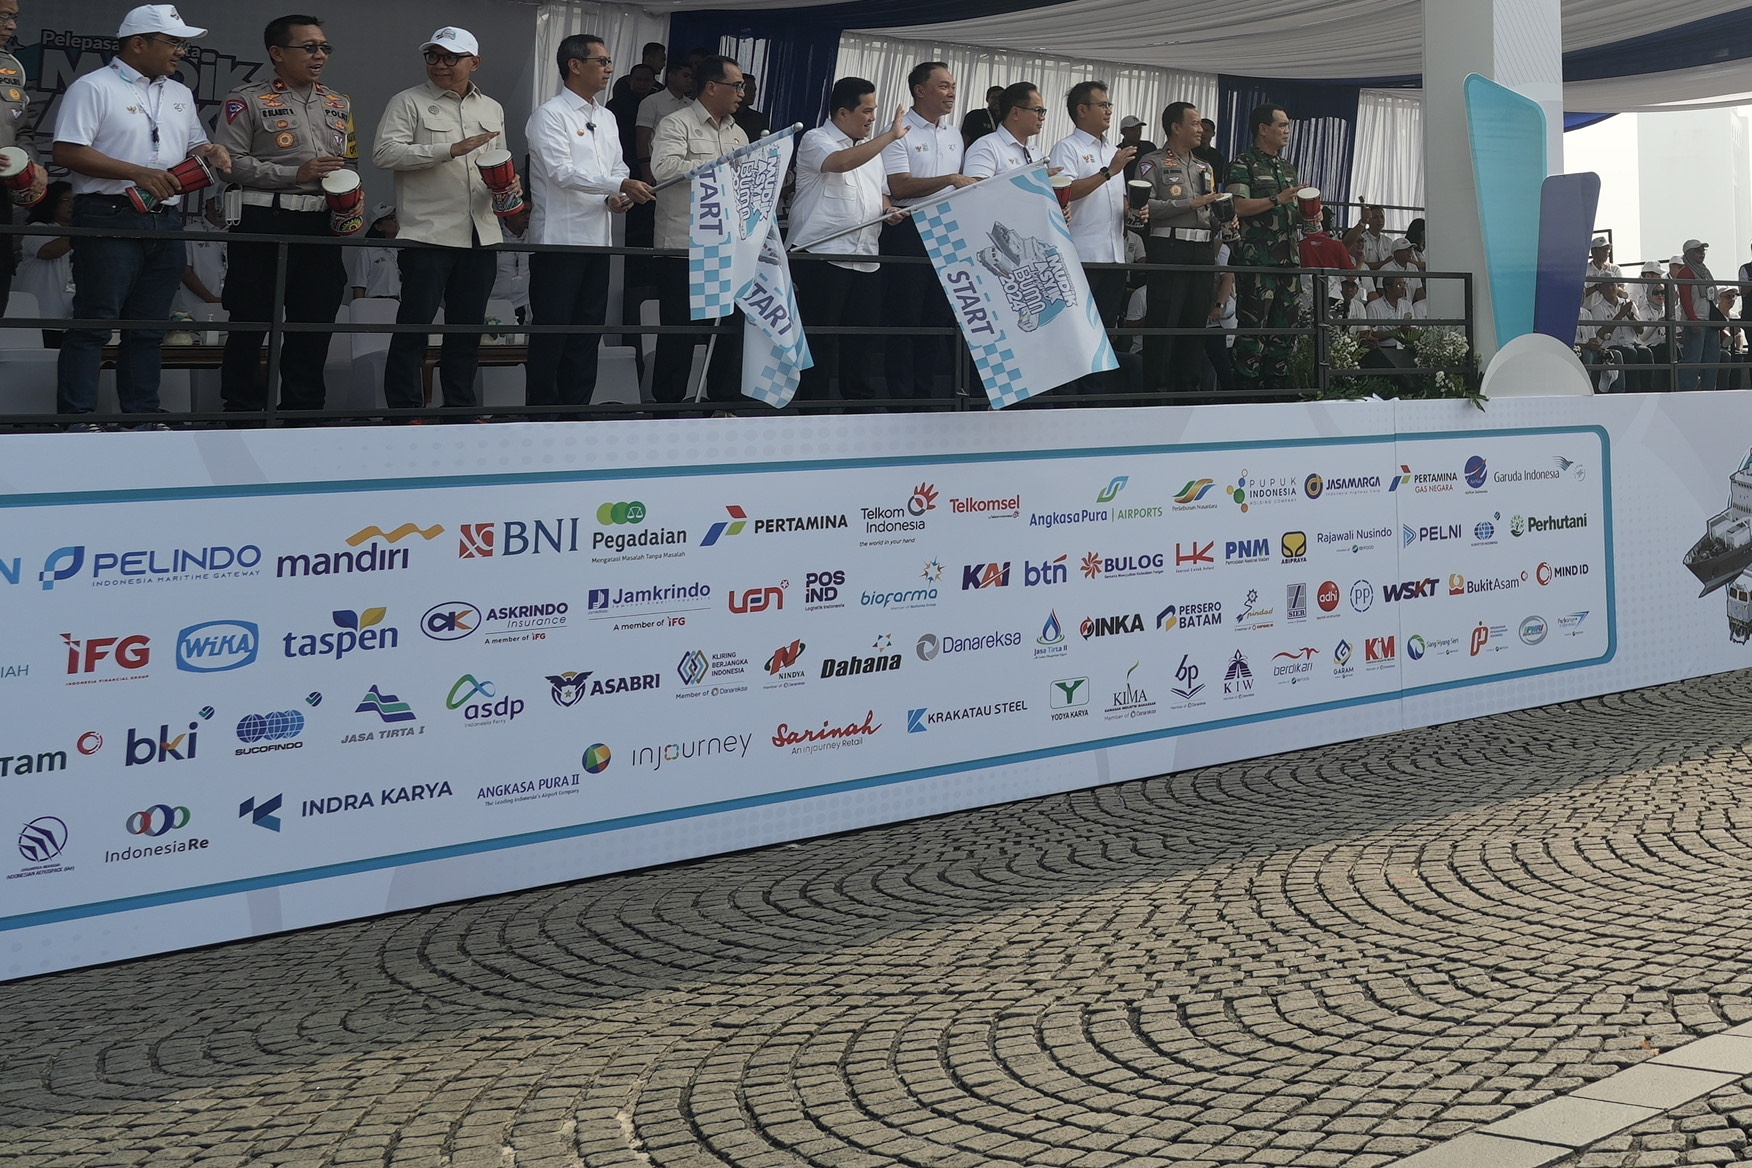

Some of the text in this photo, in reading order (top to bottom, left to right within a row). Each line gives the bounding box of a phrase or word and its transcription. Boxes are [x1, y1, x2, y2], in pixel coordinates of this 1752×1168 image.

[325, 109, 348, 122] POLRI
[998, 273, 1027, 312] 2024
[946, 270, 996, 335] START
[1249, 477, 1297, 488] PUPUK
[1326, 476, 1381, 491] JASAMARGA
[1414, 472, 1458, 484] PERTAMINA
[1494, 469, 1560, 483] Garuda Indonesia
[1249, 487, 1297, 499] INDONESIA
[1415, 484, 1454, 493] GAS NEGARA
[949, 494, 1021, 514] Telkomsel
[1117, 506, 1163, 520] AIRPORTS
[860, 506, 905, 521] Telkom
[754, 514, 849, 534] PERTAMINA
[865, 520, 926, 533] Indonesia
[1527, 513, 1588, 533] Perhutani
[501, 517, 580, 557] BNI
[592, 527, 687, 553] Pegadaian
[1316, 526, 1393, 545] Rajawali Nusindo
[1419, 524, 1462, 542] PELNI
[591, 555, 621, 564] Mengatasi
[621, 554, 645, 562] Masalah
[663, 551, 686, 559] Masalah
[1175, 540, 1215, 566] HK
[1225, 538, 1270, 559] PNM
[93, 545, 262, 579] PELINDO
[276, 542, 410, 579] mandiri
[1104, 553, 1164, 573] BULOG
[92, 569, 261, 587] INDONESIA MARITIME GATEWAY
[805, 570, 846, 588] POS
[1024, 558, 1069, 587] btn
[1554, 563, 1589, 578] MIND ID
[612, 581, 711, 605] Jamkrindo
[860, 588, 939, 609] biofarma
[1319, 590, 1338, 603] adhi
[1383, 577, 1440, 603] WSKT
[486, 601, 568, 621] ASKRINDO
[1179, 601, 1222, 616] PERSERO
[1288, 609, 1306, 619] SIER
[507, 615, 567, 629] Insurance
[613, 619, 664, 631] A member of
[1094, 613, 1145, 637] INKA
[1179, 613, 1222, 630] BATAM
[283, 623, 399, 660] taspen
[491, 635, 521, 644] member
[942, 631, 1022, 654] Danareksa
[711, 651, 737, 661] KLIRING
[1034, 646, 1046, 657] Jasa
[711, 658, 749, 669] BERJANGKA
[711, 667, 745, 677] INDONESIA
[820, 653, 902, 680] Dahana
[1273, 662, 1313, 677] berdikari
[1333, 666, 1355, 675] GARAM
[778, 671, 806, 680] NINDYA
[589, 673, 661, 698] ASABRI
[675, 689, 709, 700] Member of
[1112, 683, 1148, 707] KIMA
[464, 695, 525, 721] asdp
[928, 700, 1028, 724] KRAKATAU STEEL
[340, 727, 416, 744] JASA TIRTA
[771, 709, 883, 748] Sarinah
[125, 720, 199, 768] bki
[234, 741, 304, 756] SUCOFINDO
[791, 737, 863, 755] An Retail
[477, 780, 535, 800] ANGKASA
[538, 775, 570, 791] PURA
[301, 780, 453, 817] INDRA KARYA
